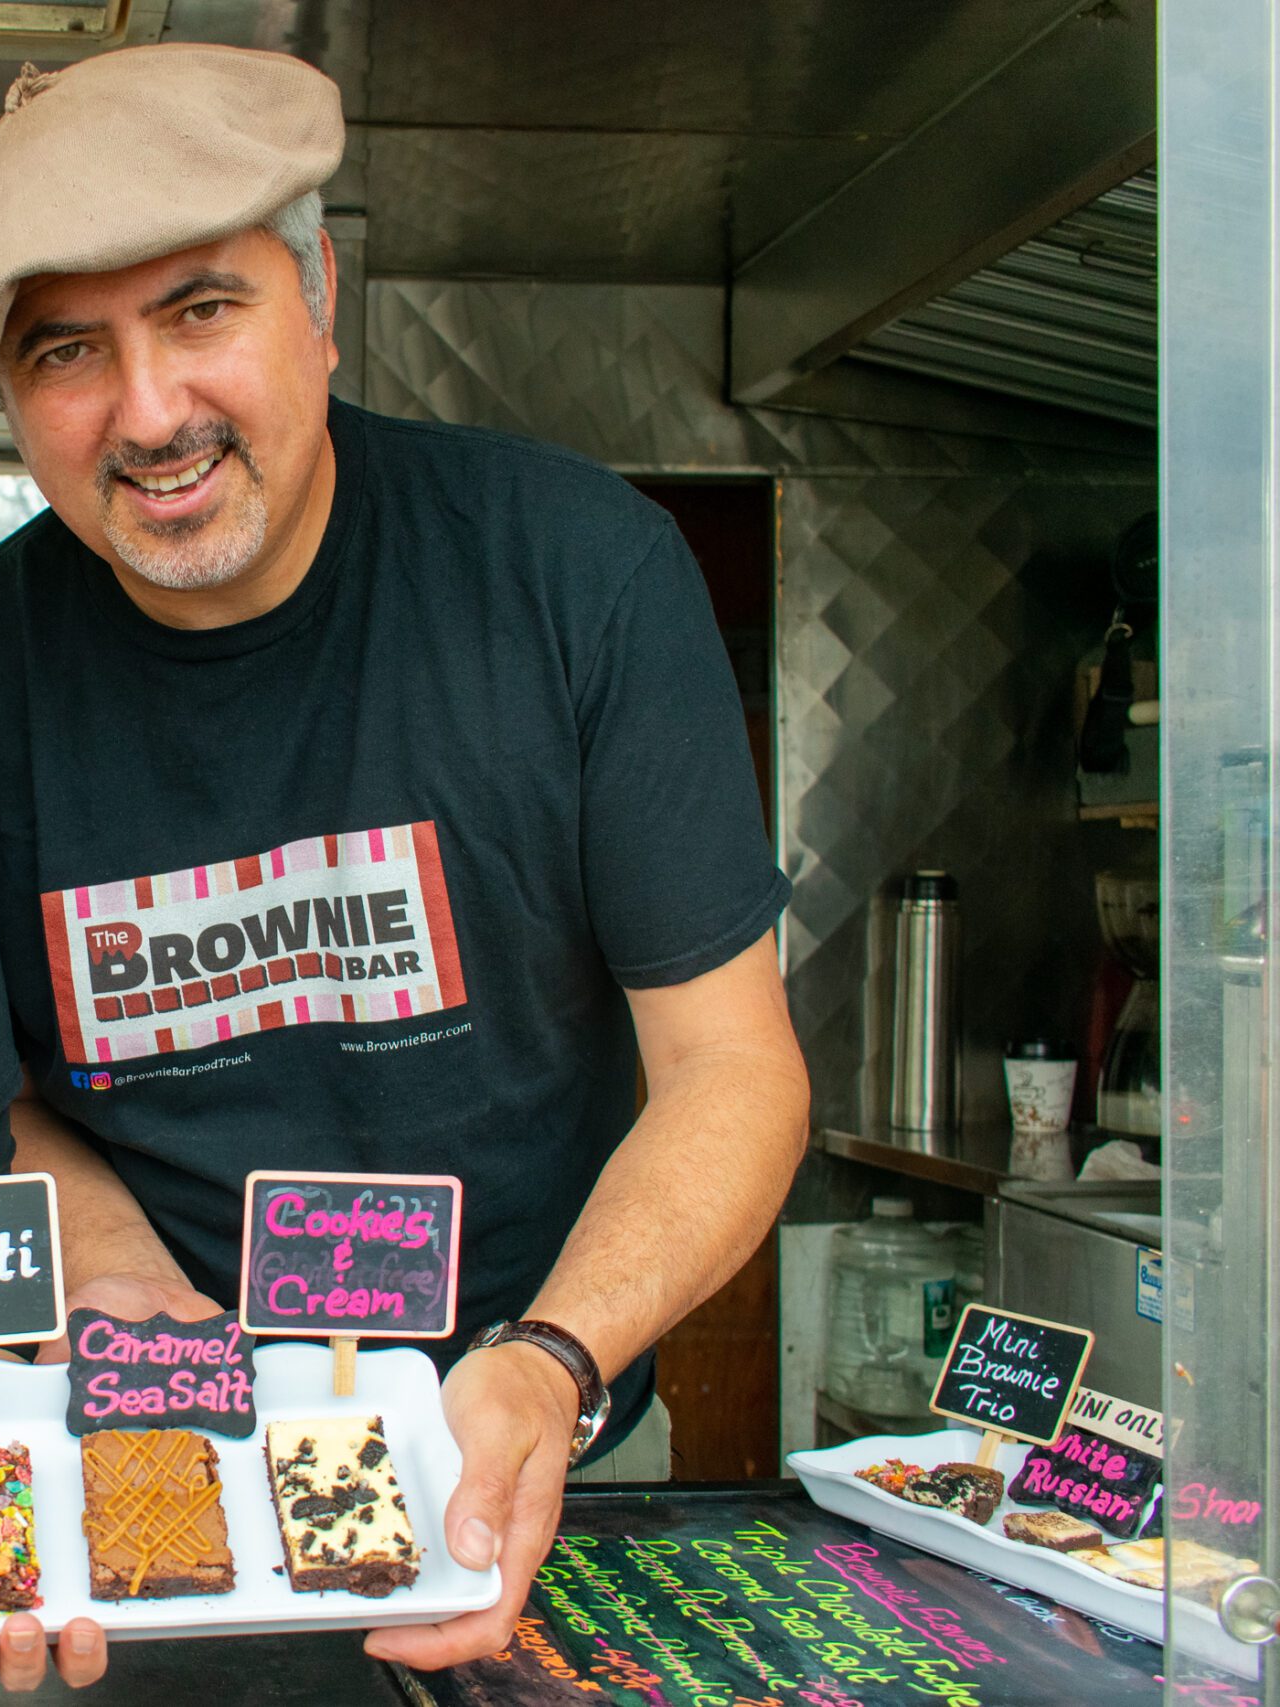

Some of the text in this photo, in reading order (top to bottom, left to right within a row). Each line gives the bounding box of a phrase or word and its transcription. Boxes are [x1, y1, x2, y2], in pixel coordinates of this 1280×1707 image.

[85, 888, 415, 994] BROWNIE
[91, 929, 129, 948] The
[345, 950, 424, 981] BAR
[340, 1021, 472, 1053] www.BrownieBar.com
[114, 1051, 252, 1087] @BrownieBarFoodTruck
[266, 1192, 433, 1249] Cookies
[268, 1274, 404, 1319] Cream
[78, 1319, 243, 1366] Caramel
[976, 1317, 1044, 1359] Mini
[83, 1369, 253, 1418] Sea Salt
[951, 1343, 1061, 1399] Brownie
[959, 1384, 1016, 1421] Trio
[1024, 1458, 1136, 1522] Russian
[823, 1542, 919, 1604] Brownie
[691, 1540, 899, 1684] Caramel Sea Salt
[734, 1520, 981, 1707] Triple Chocolate Fudge
